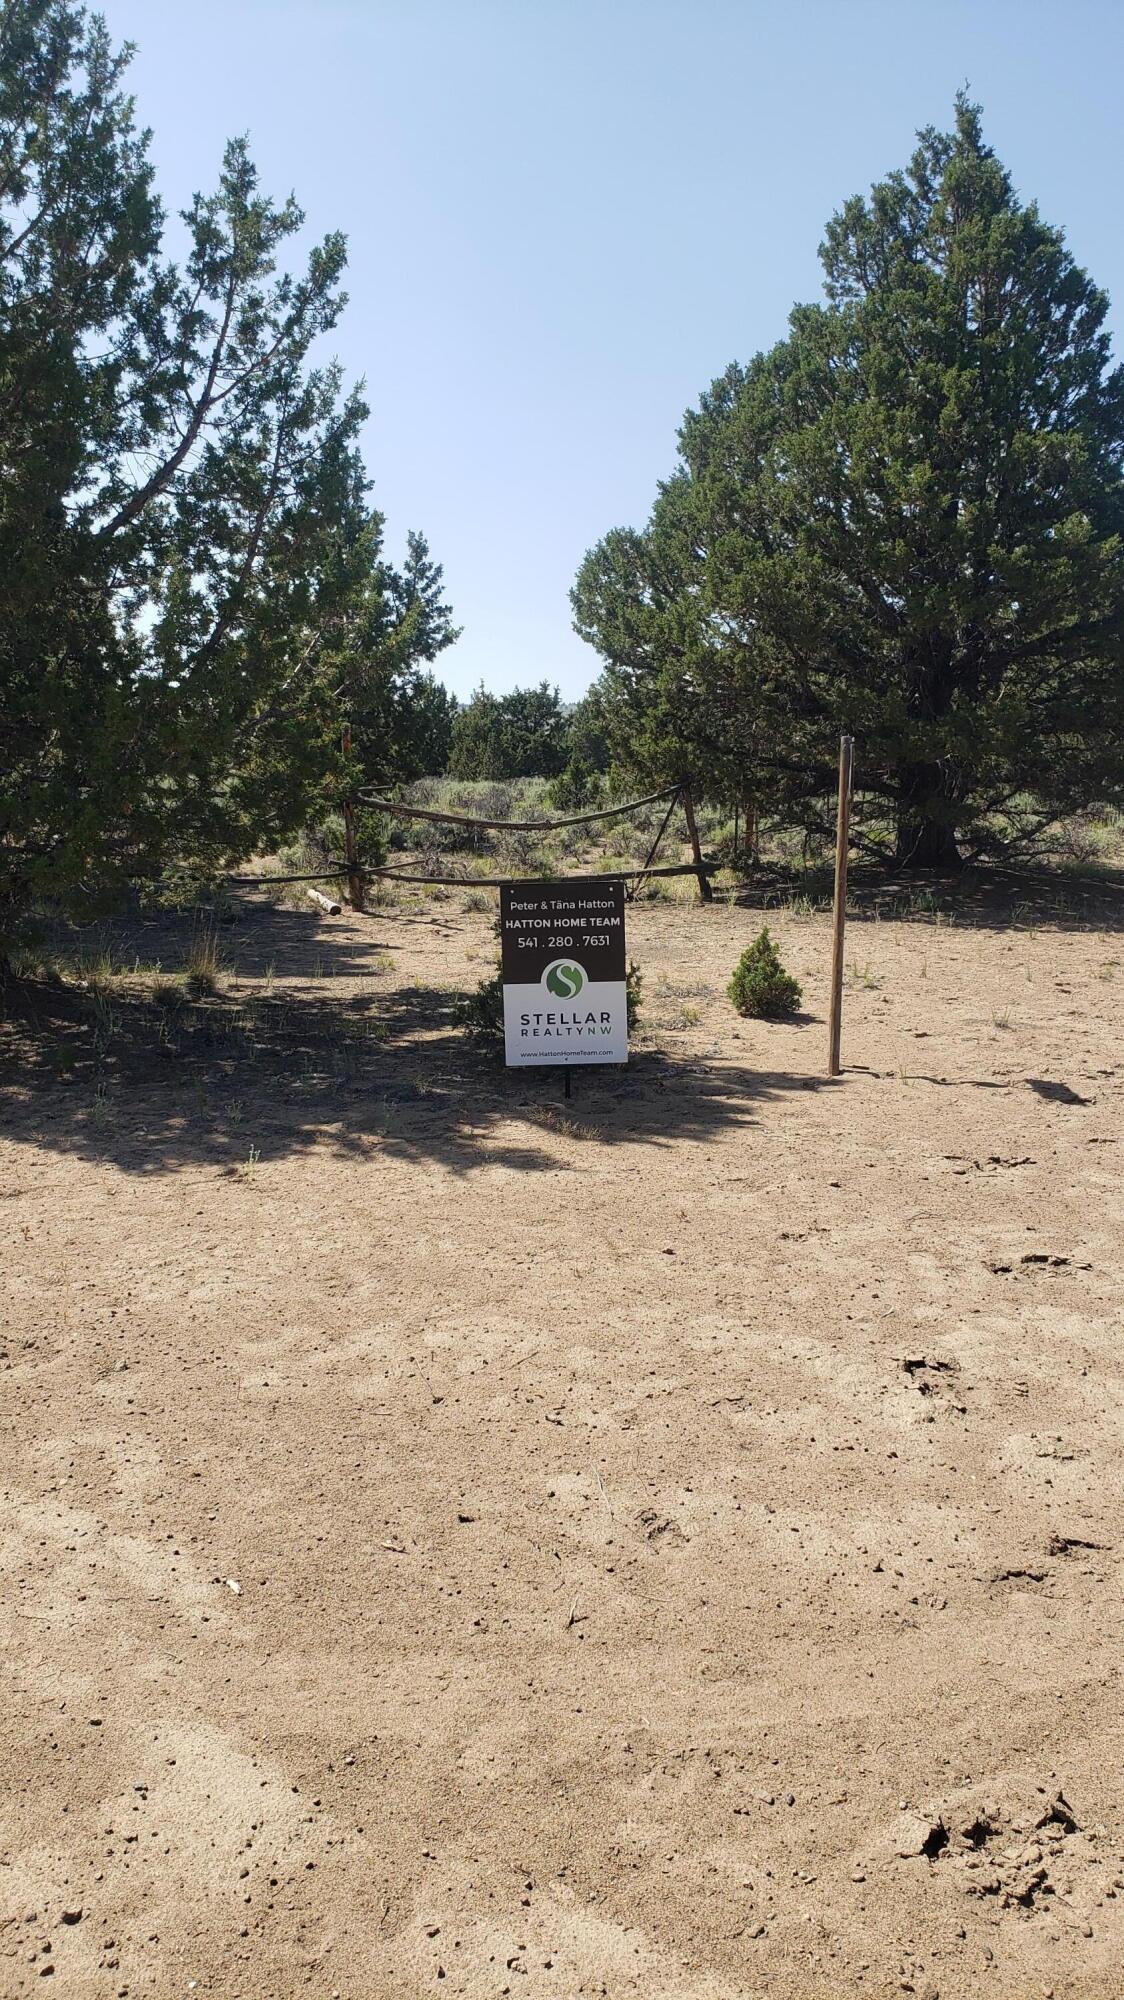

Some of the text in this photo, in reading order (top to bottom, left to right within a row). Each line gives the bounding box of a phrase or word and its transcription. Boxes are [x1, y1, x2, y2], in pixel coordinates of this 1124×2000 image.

[510, 901, 539, 911] Peter
[540, 901, 549, 910] &
[578, 899, 615, 909] Hatton
[505, 917, 620, 929] HATTON HOME TEAM
[518, 937, 538, 948] 541
[547, 936, 573, 947] 280
[582, 935, 610, 947] 7631
[520, 1012, 611, 1026] STELLAR
[520, 1050, 614, 1058] www.HattonHomeTeam.com
